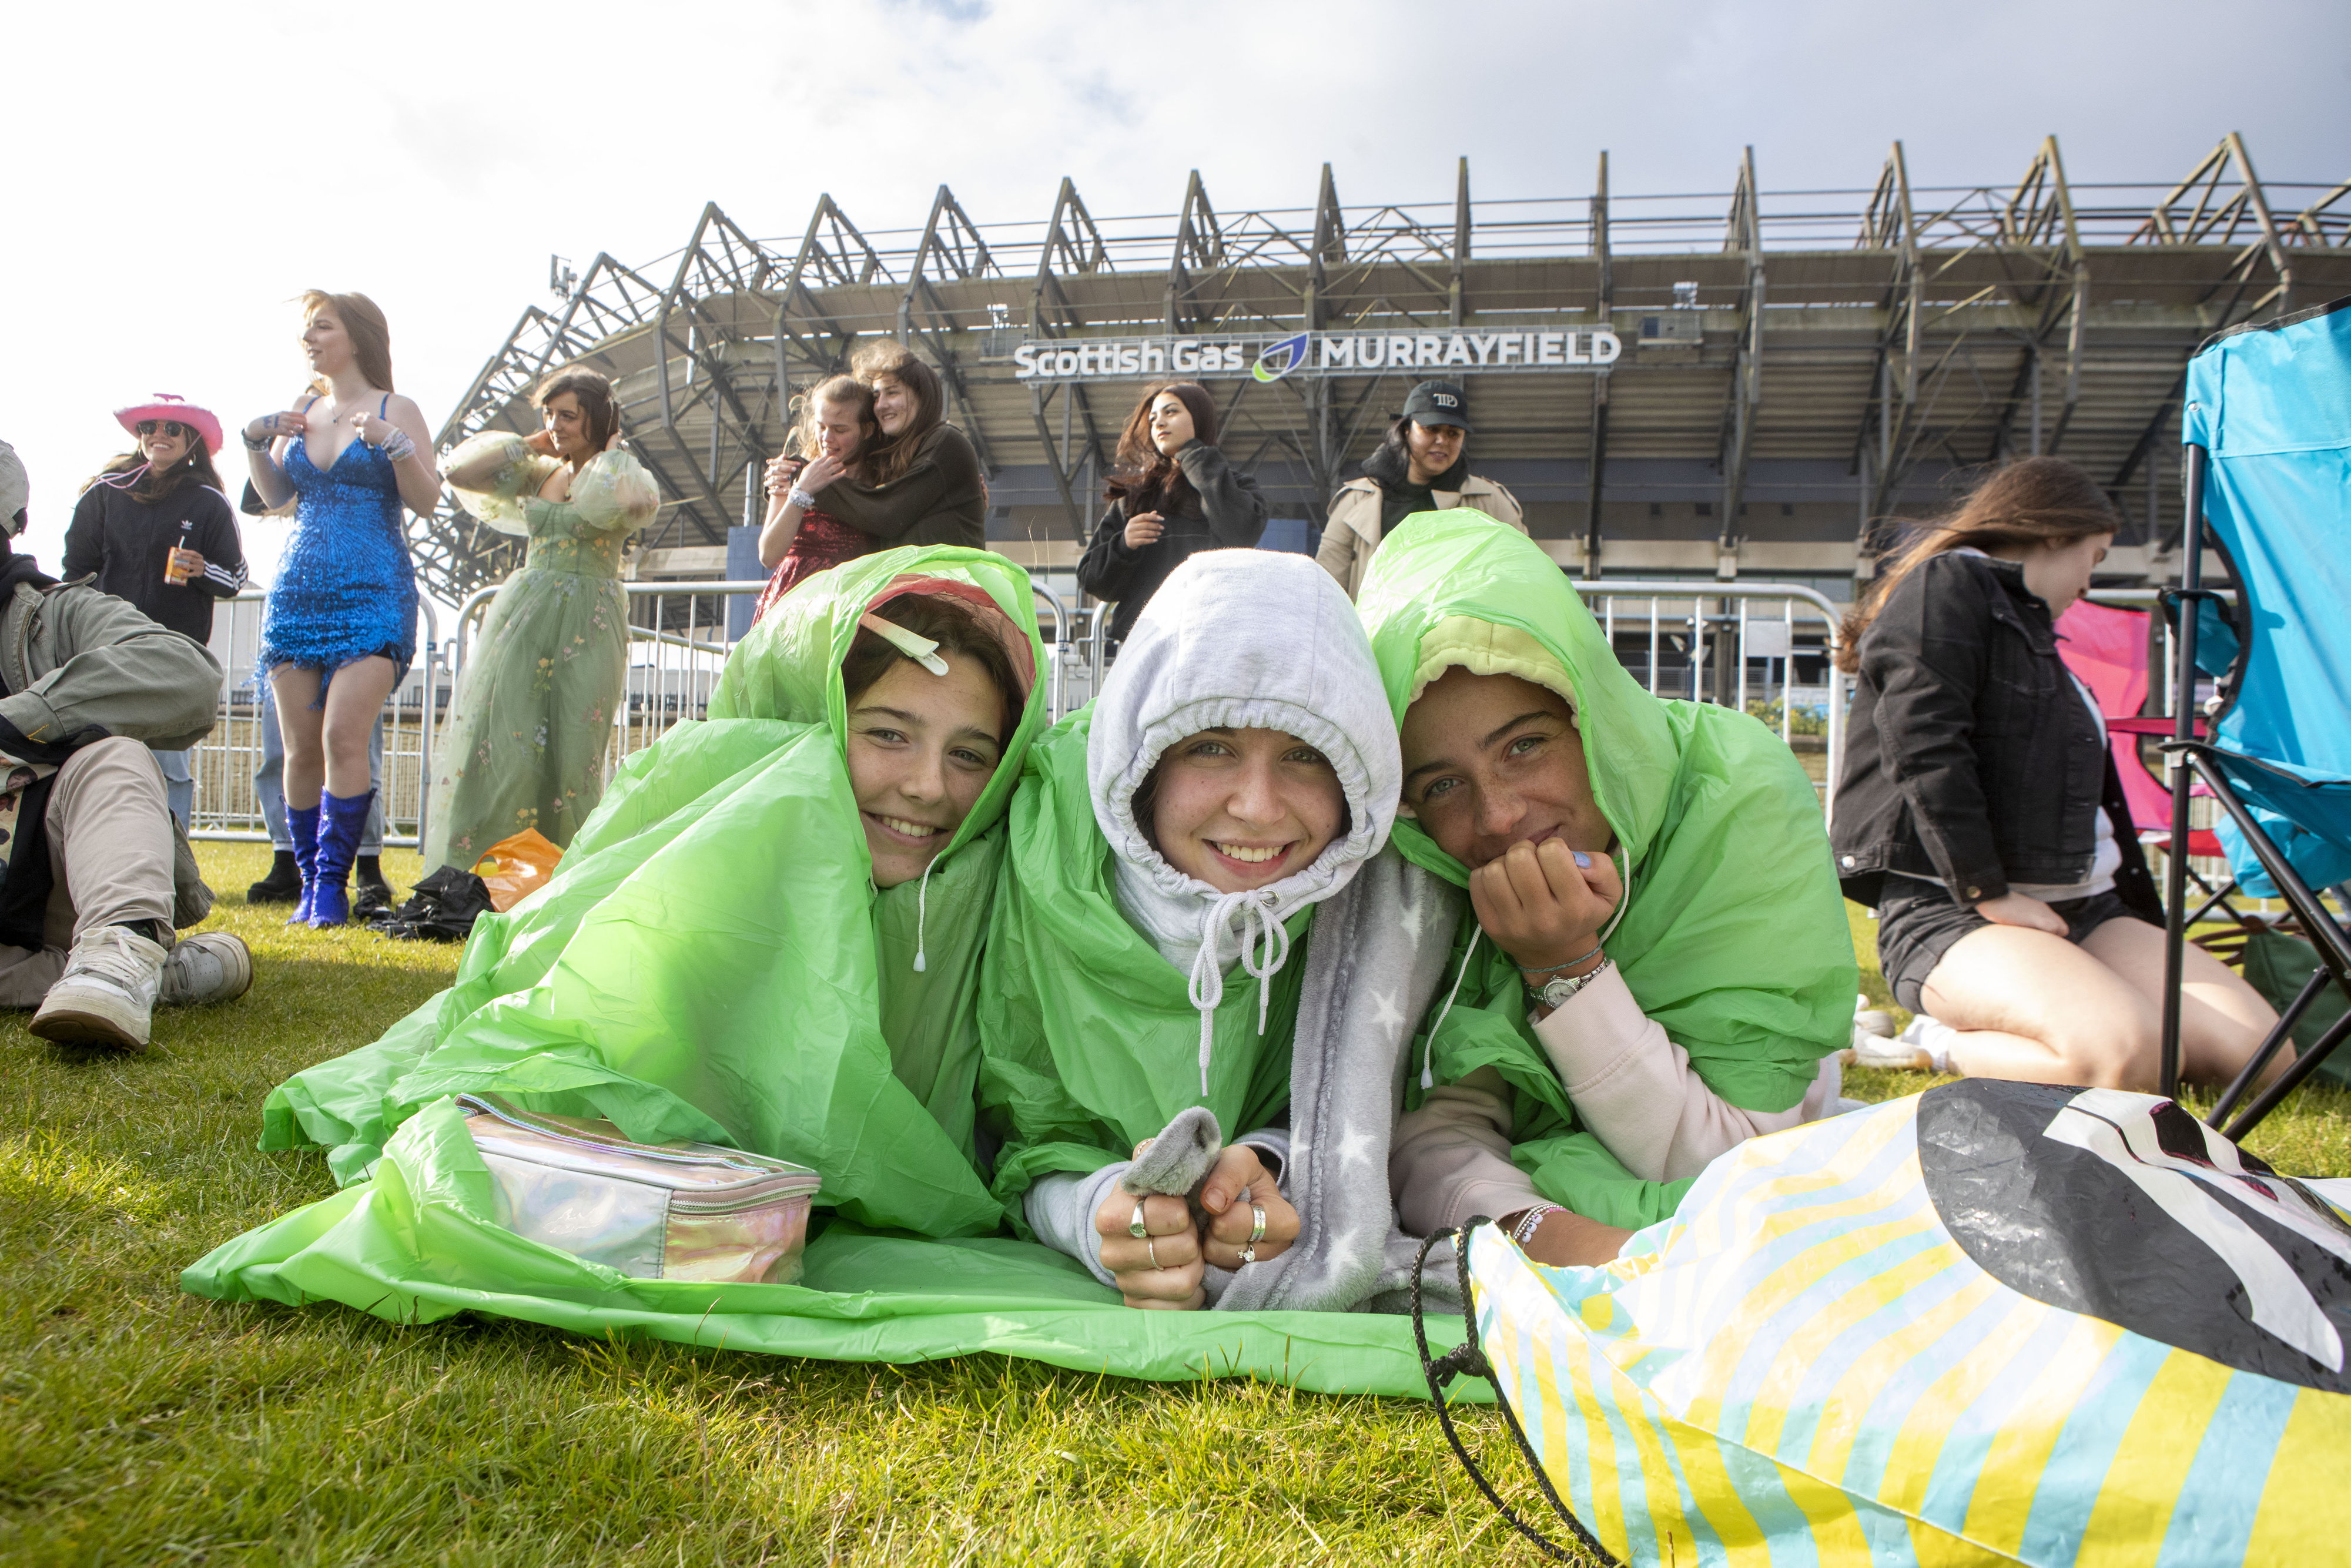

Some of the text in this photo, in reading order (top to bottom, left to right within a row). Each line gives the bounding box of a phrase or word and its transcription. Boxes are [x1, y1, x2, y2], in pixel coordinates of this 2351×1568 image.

[1014, 331, 1622, 378] Scottish Gas MURRAYFIELD
